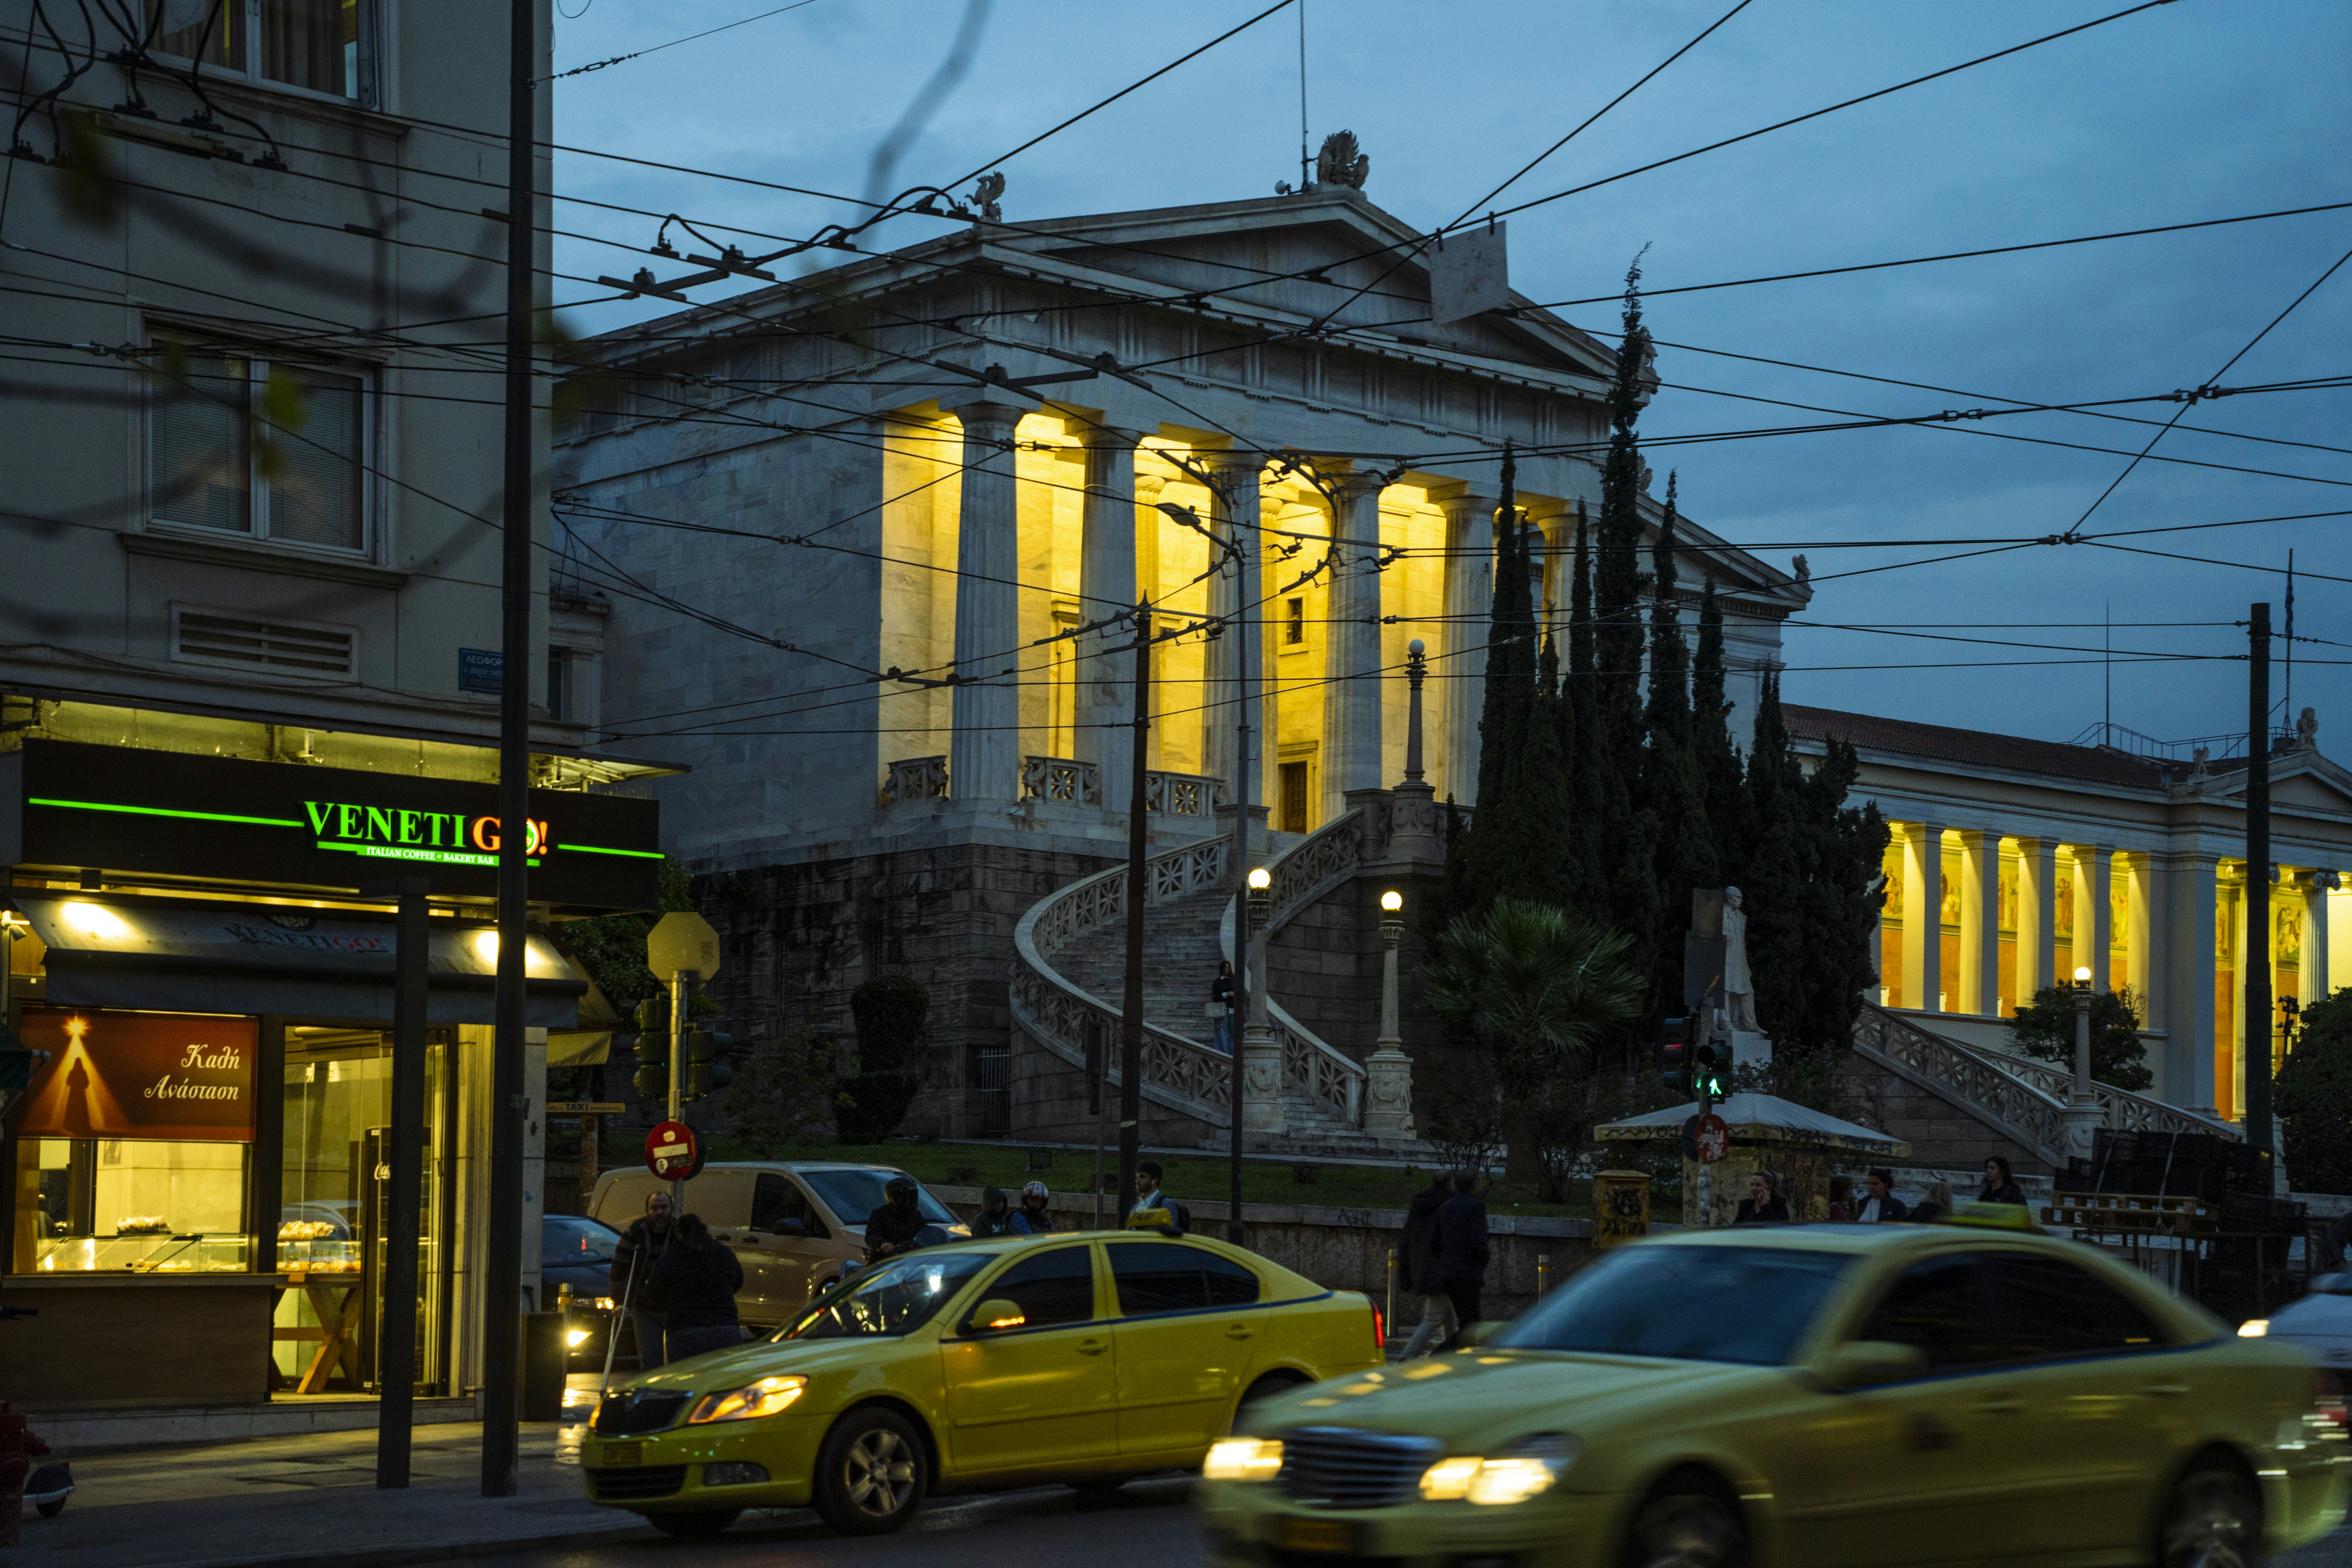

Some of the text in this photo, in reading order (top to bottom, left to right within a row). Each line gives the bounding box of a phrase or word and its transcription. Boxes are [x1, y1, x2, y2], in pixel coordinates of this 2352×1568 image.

[466, 655, 503, 666] ΛΕΩΦΟΡ
[367, 847, 494, 865] ITALIAN COFFEE BAKERY BAR
[181, 1044, 240, 1069] Καλή
[144, 1074, 238, 1100] Ανάσταση
